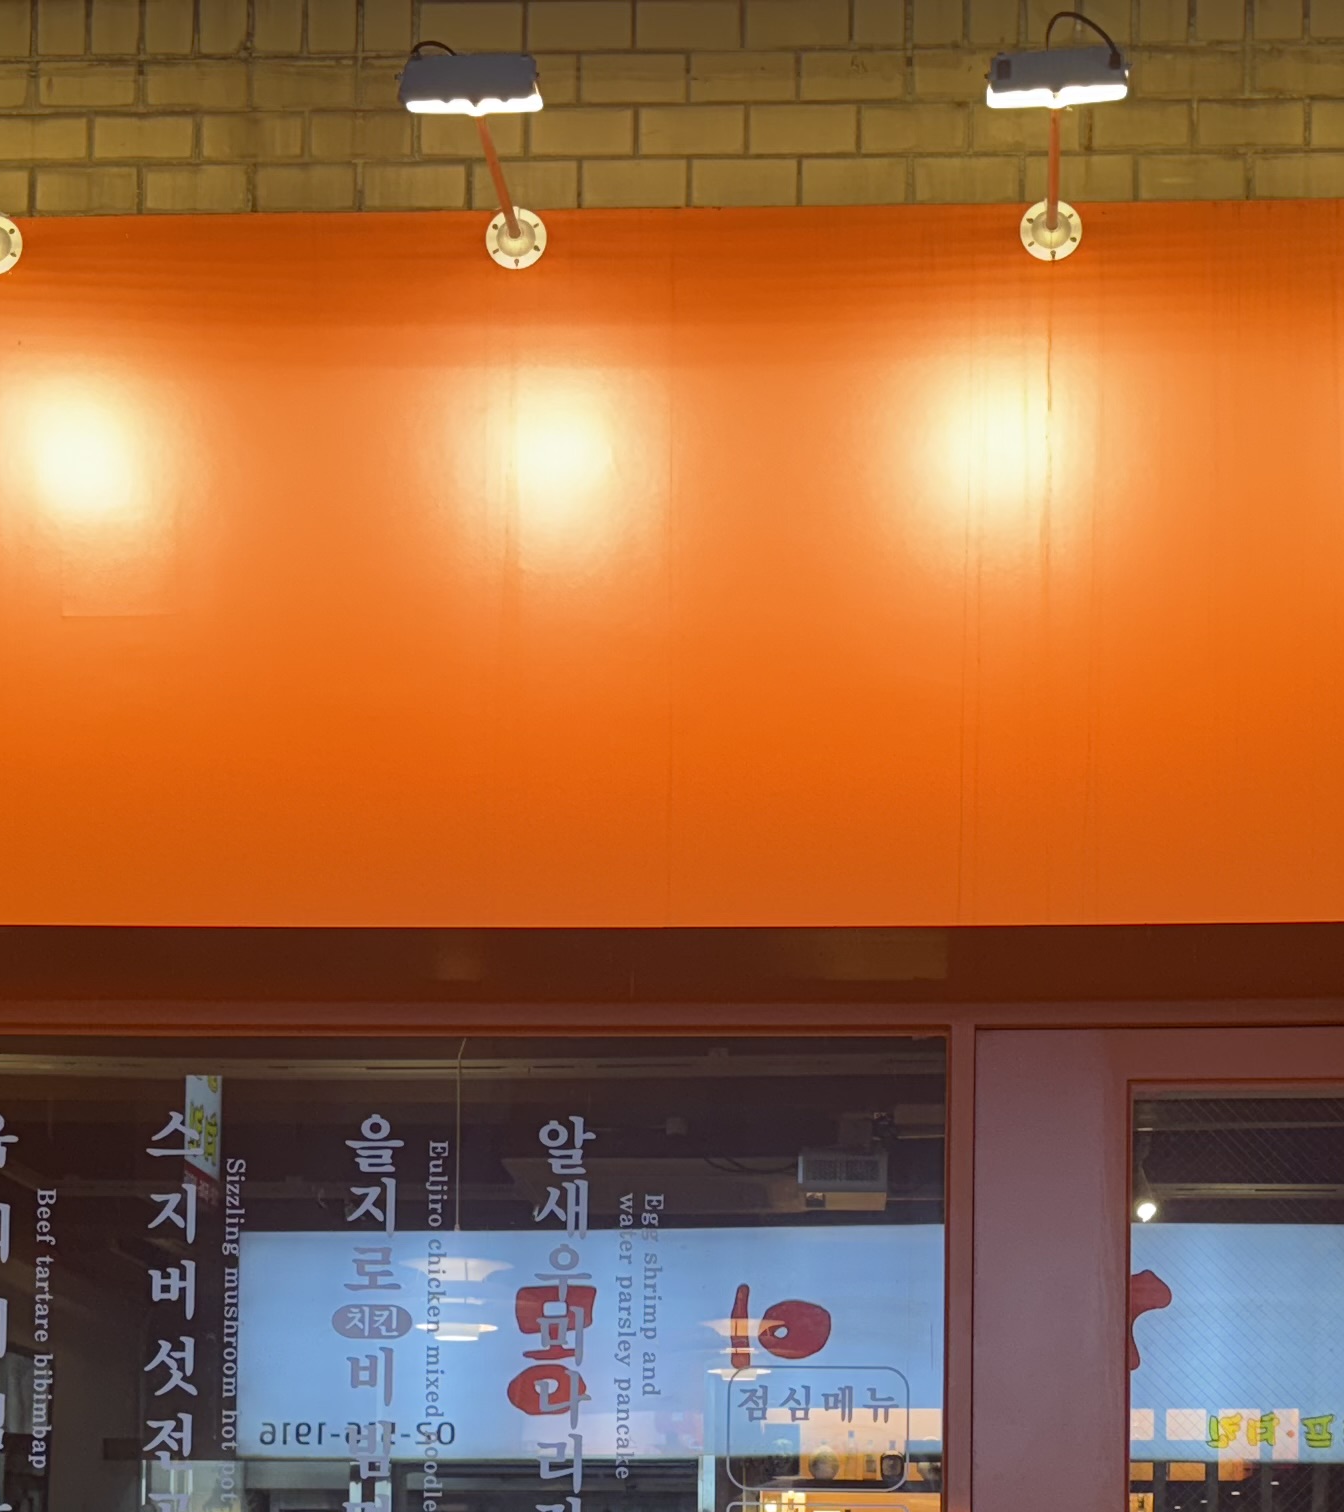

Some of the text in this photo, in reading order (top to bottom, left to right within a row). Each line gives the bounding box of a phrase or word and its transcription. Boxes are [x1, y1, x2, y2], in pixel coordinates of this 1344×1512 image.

[221, 1158, 246, 1257] Sizzling
[425, 1140, 449, 1228] Euljiro
[28, 1188, 57, 1469] Beef tartare bibimbap
[222, 1267, 242, 1398] mushroom
[424, 1239, 446, 1335] chicken
[640, 1193, 664, 1397] Egg shrimp and
[424, 1345, 445, 1418] mixed
[614, 1193, 638, 1481] water parsley pancake
[221, 1408, 240, 1450] hot
[738, 1384, 899, 1423] 점심메뉴
